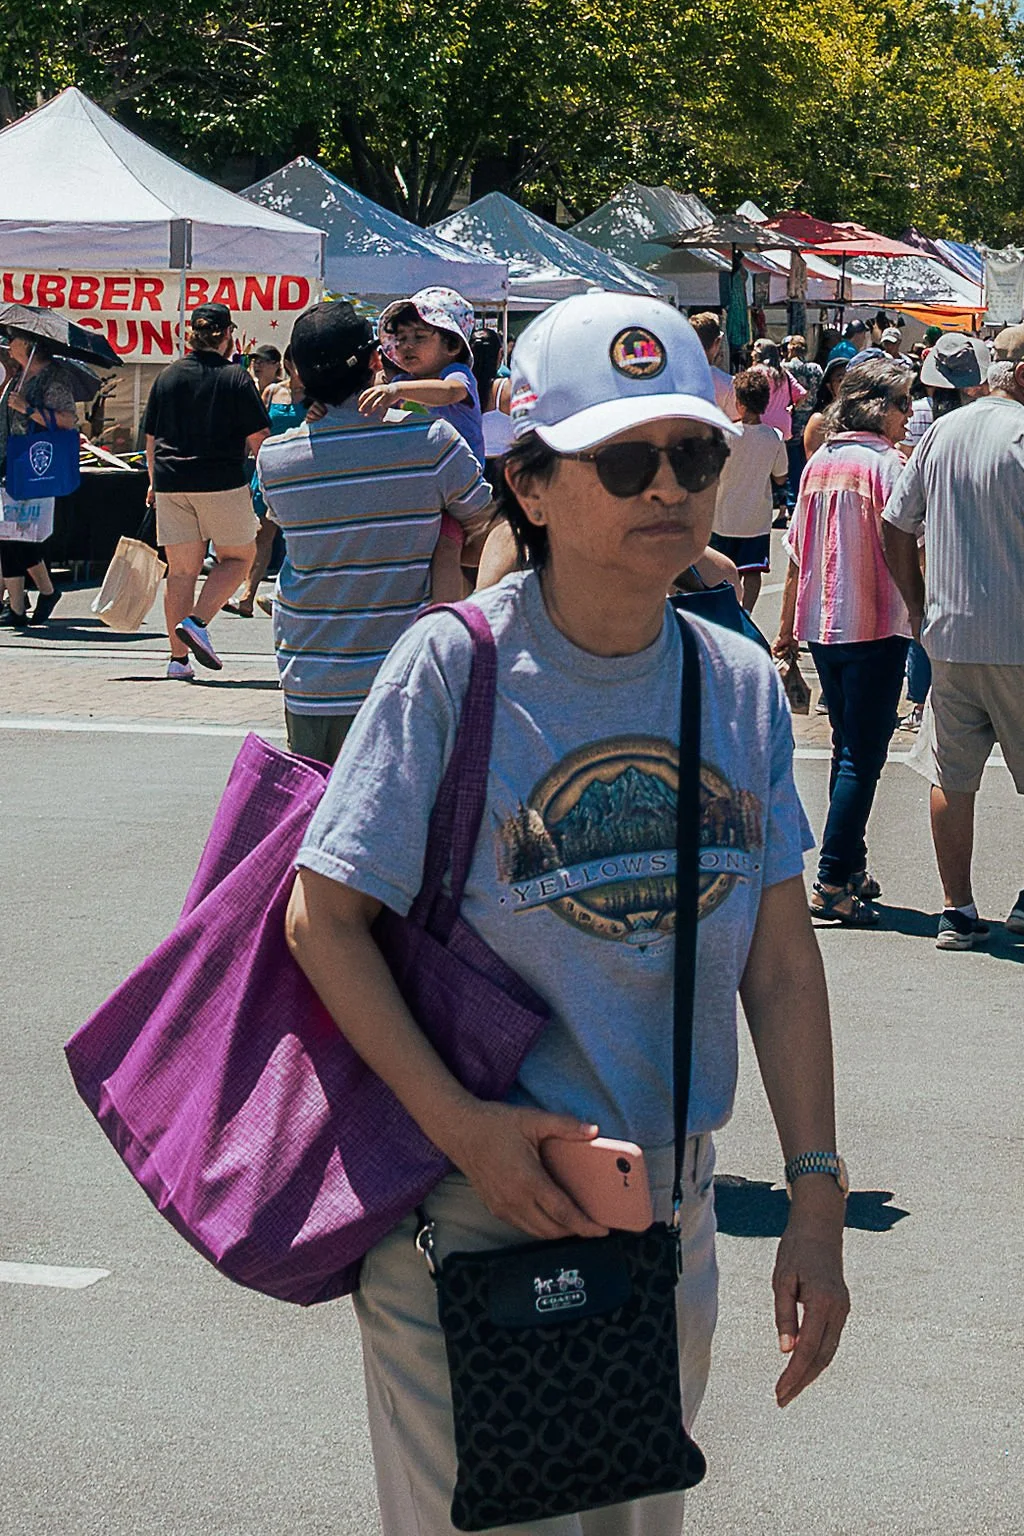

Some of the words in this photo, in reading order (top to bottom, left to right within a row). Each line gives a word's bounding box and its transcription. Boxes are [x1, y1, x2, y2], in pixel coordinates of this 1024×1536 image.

[0, 273, 164, 311] UBBER
[178, 275, 310, 312] BAND
[513, 851, 751, 902] YELLOWSONE
